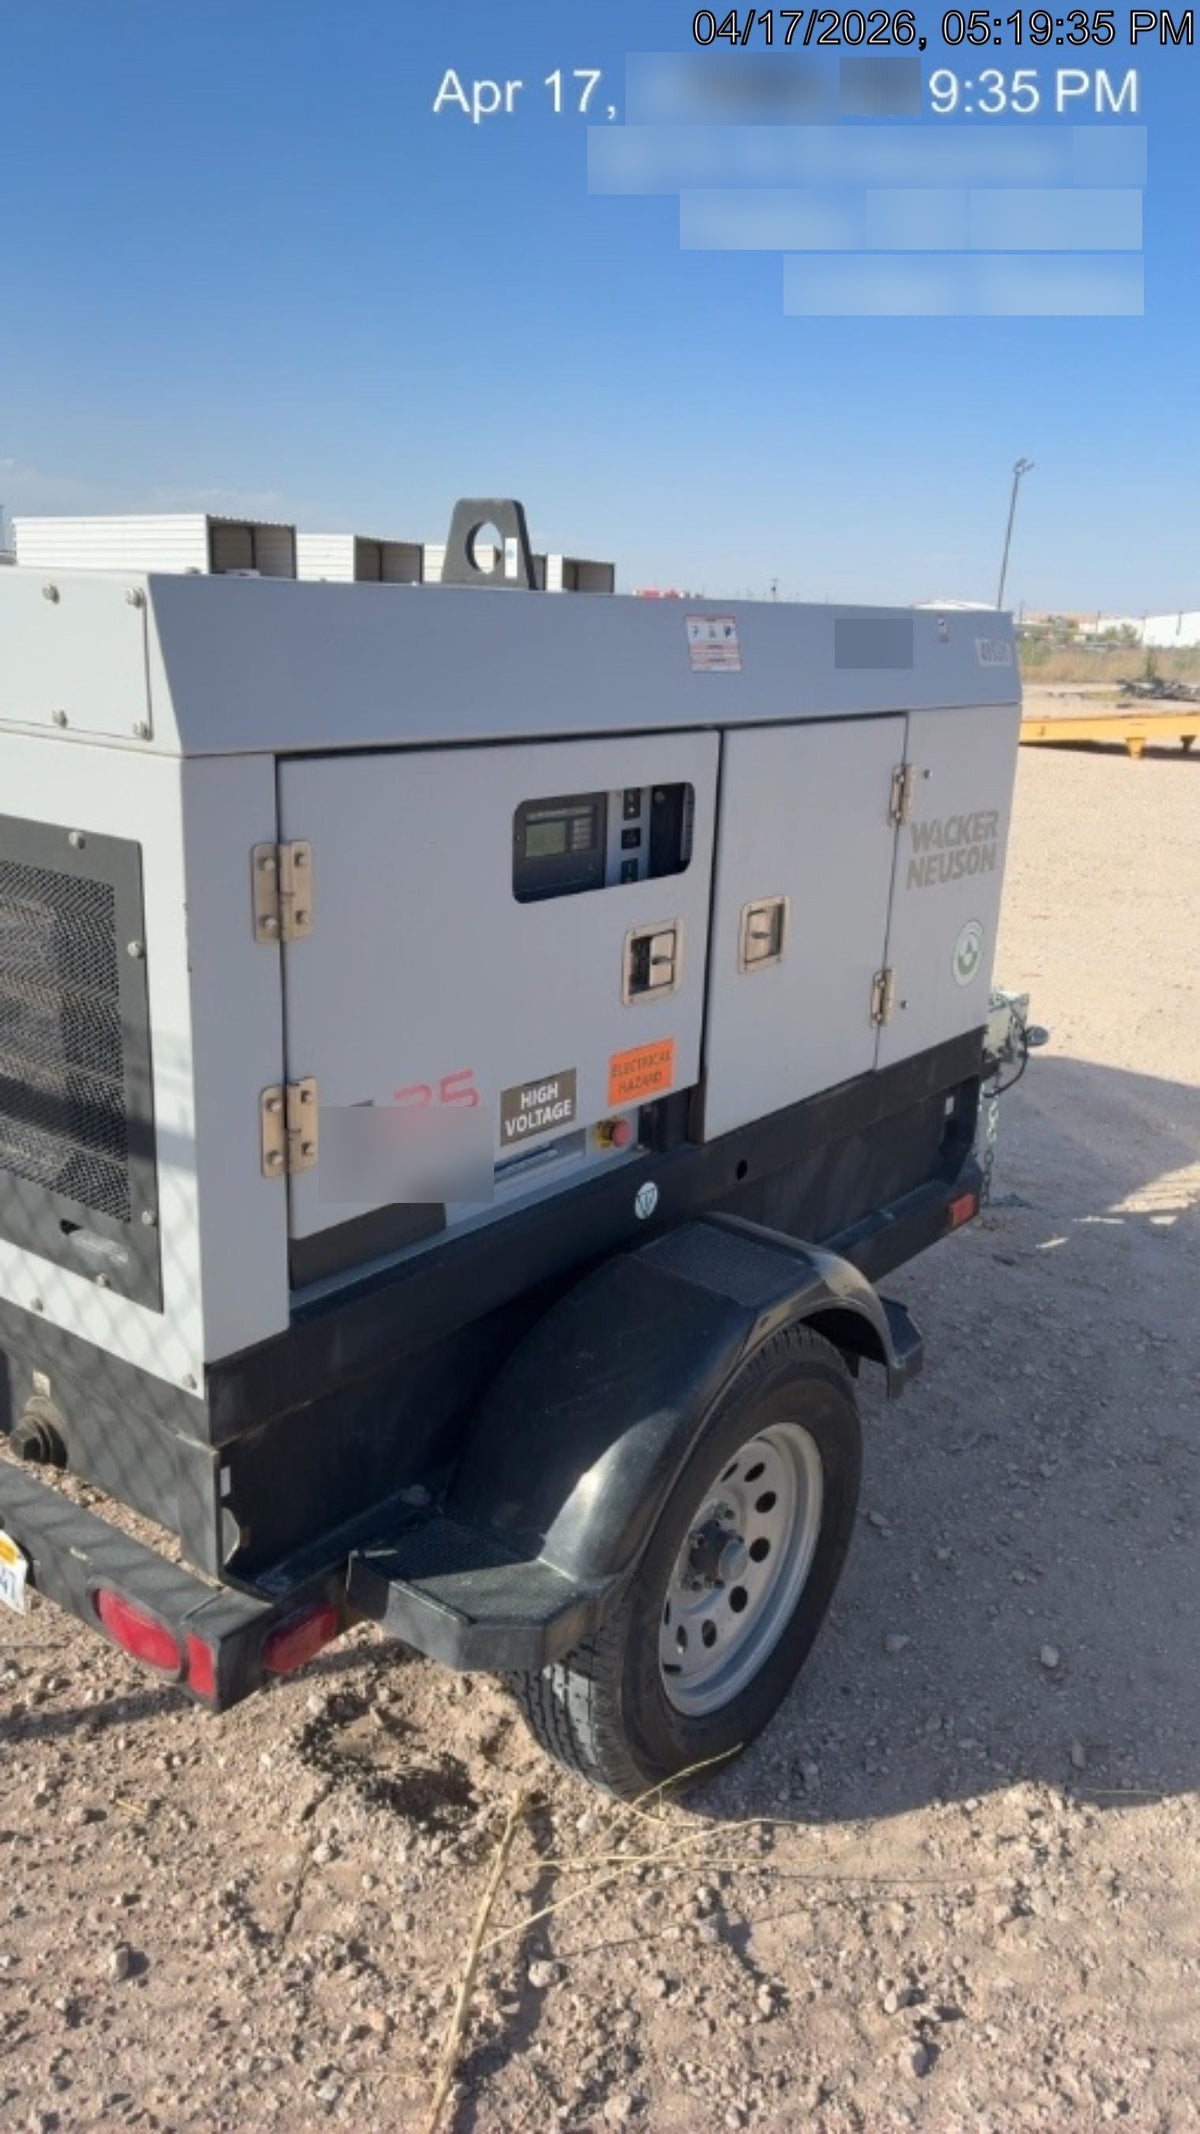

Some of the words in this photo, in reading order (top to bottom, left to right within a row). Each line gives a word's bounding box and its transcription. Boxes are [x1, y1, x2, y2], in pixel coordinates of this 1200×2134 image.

[910, 810, 999, 853] WACKER
[906, 842, 998, 892] NEUSON
[611, 1050, 671, 1078] ELECTRICAL
[521, 1081, 558, 1110] HIGH
[505, 1100, 572, 1136] VOLTAGE
